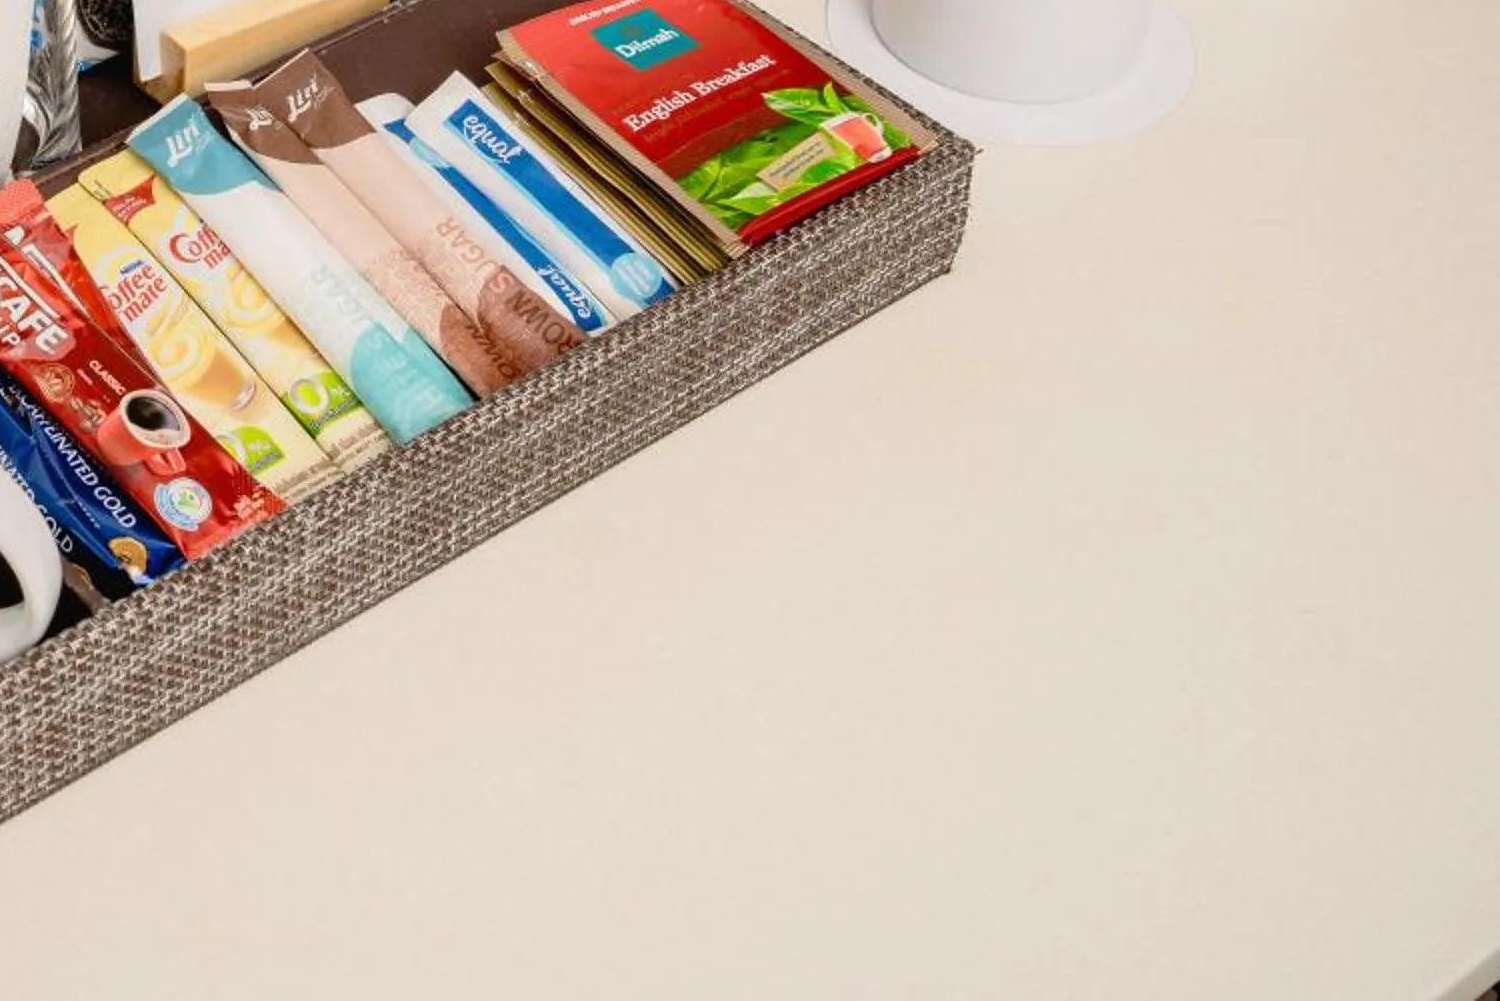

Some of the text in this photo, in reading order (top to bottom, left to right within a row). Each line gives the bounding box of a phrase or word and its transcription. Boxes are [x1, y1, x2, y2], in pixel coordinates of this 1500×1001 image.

[614, 28, 680, 59] Dilmah
[622, 88, 699, 133] English
[689, 53, 778, 97] Breakfast
[462, 114, 523, 165] equal
[168, 226, 220, 265] Coff
[203, 241, 232, 270] ma
[436, 217, 515, 293] SUGAR
[100, 264, 157, 310] offee
[122, 276, 168, 323] mate
[536, 263, 594, 323] equal
[507, 290, 573, 356] ROWN
[89, 360, 127, 396] CLASSIC
[93, 485, 137, 529] GOLD
